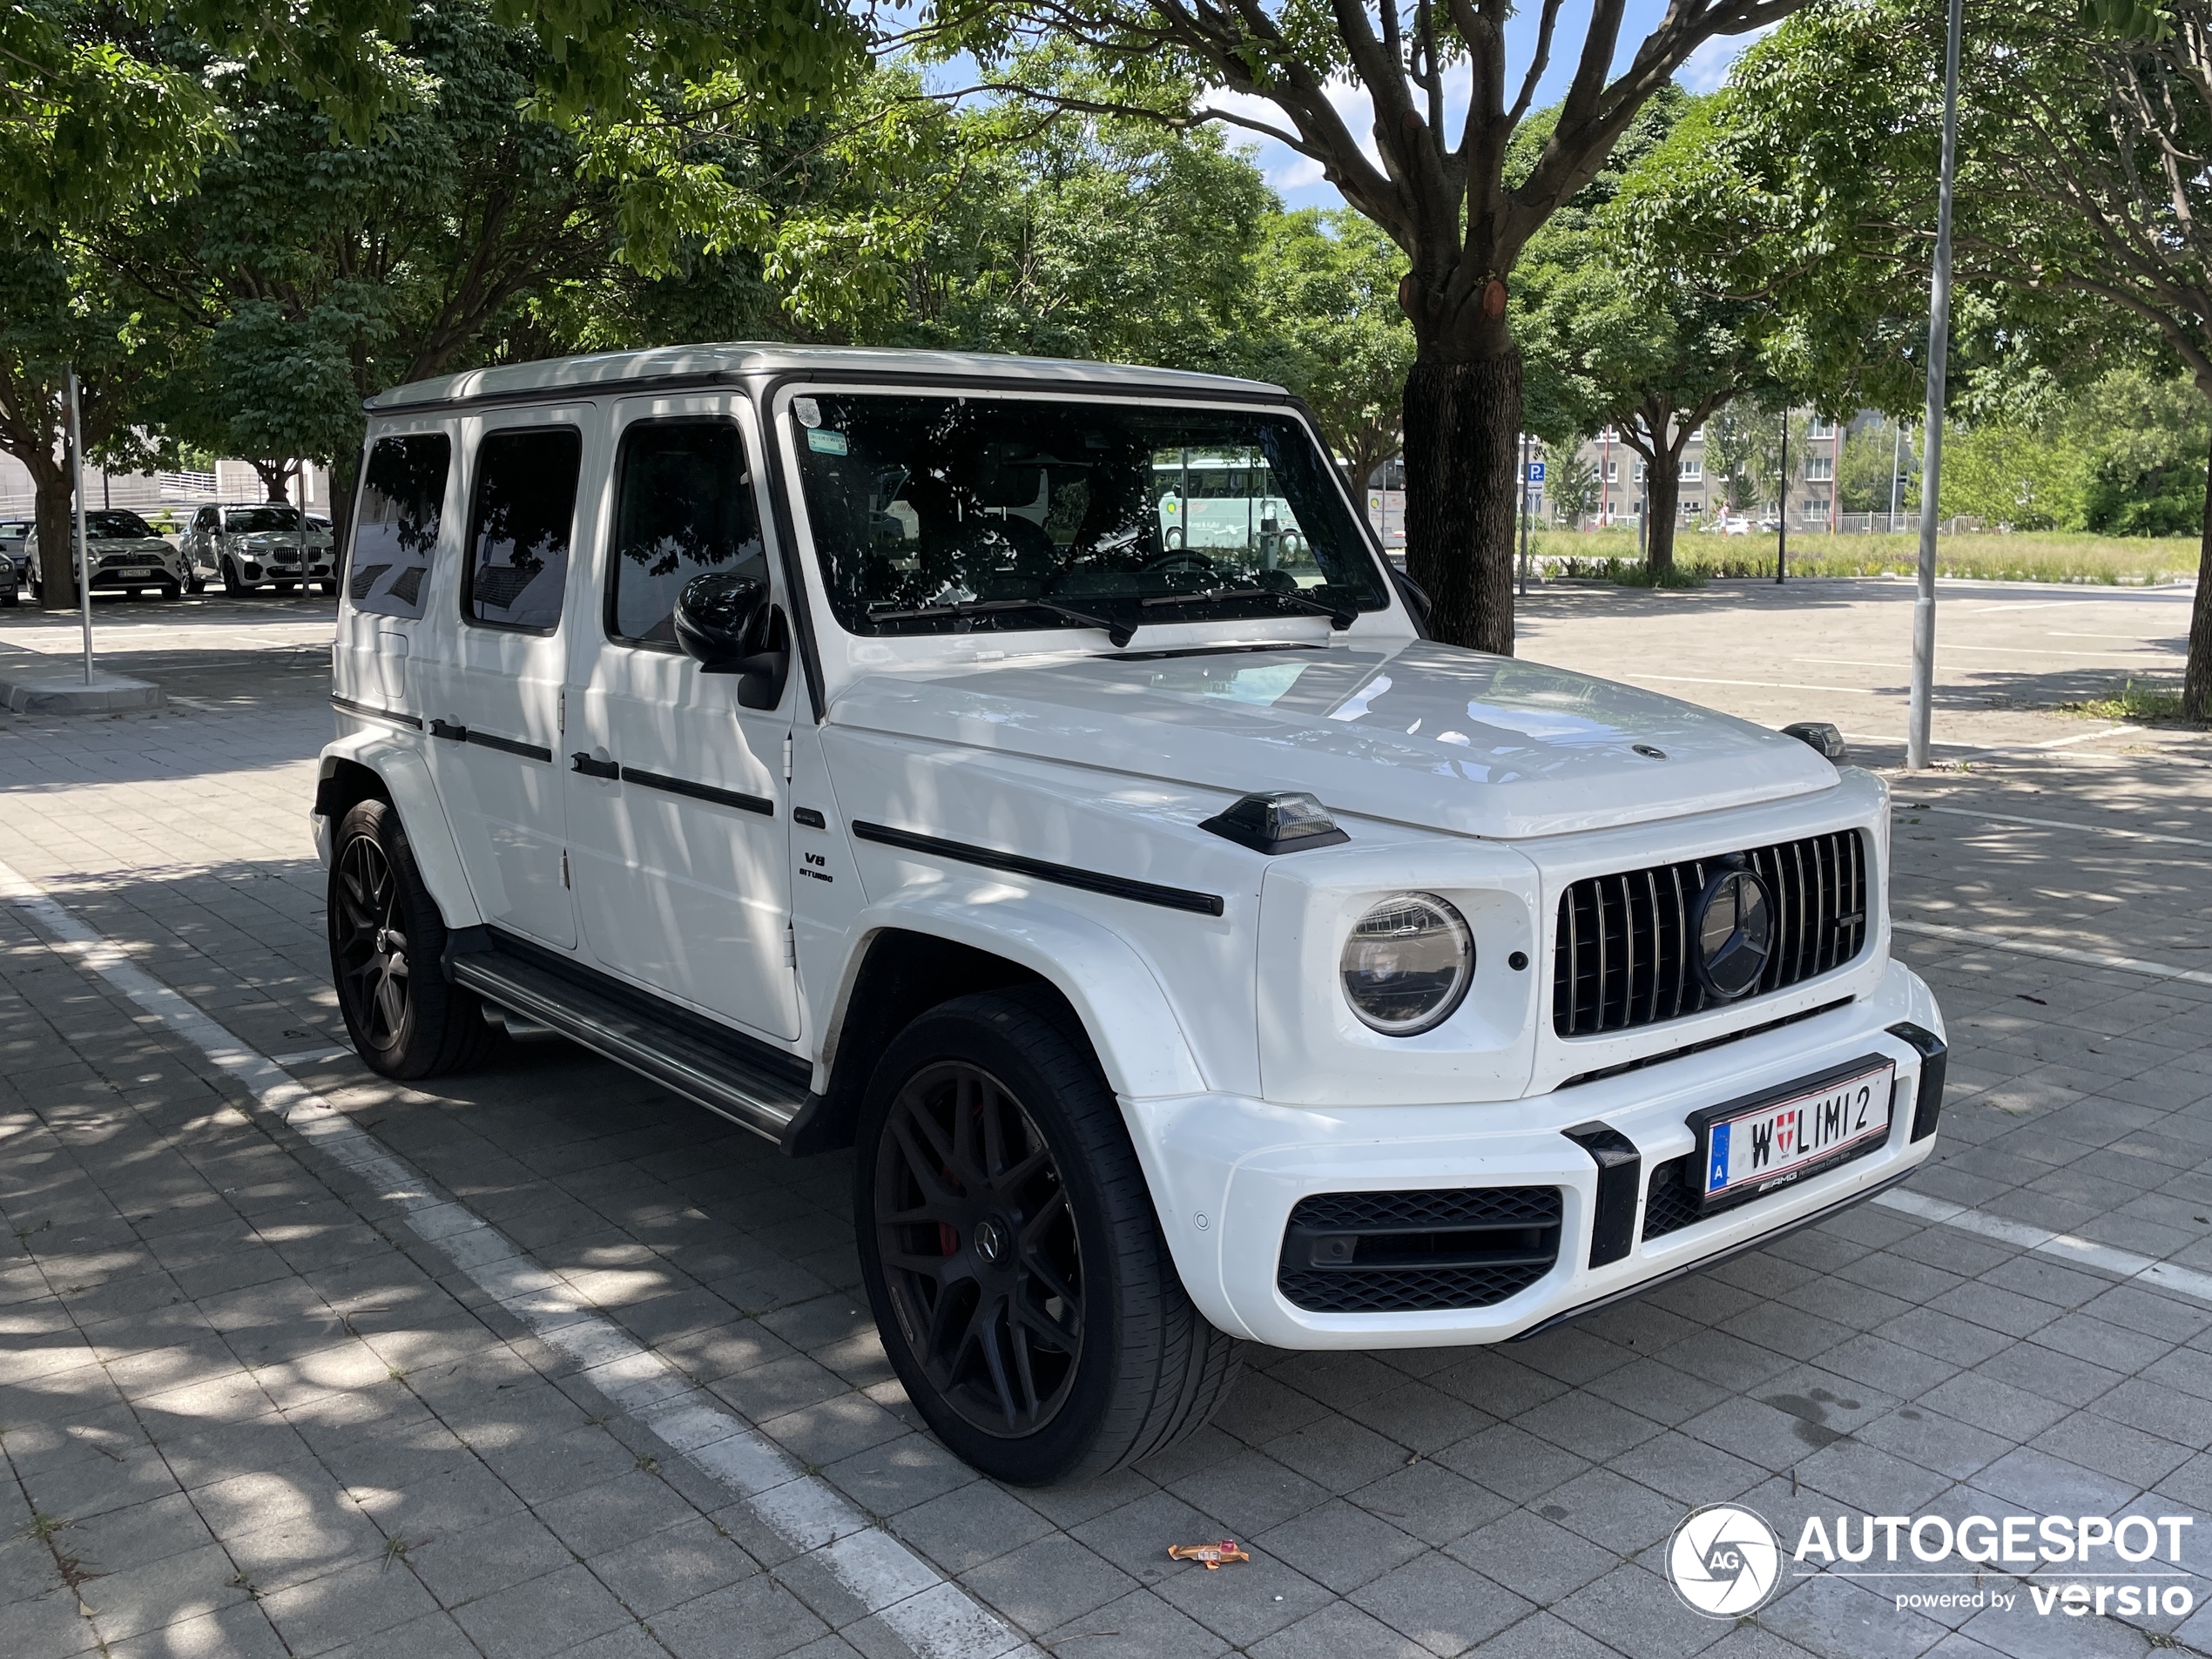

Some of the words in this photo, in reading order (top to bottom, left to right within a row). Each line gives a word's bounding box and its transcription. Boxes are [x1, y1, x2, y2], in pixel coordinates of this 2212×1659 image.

[1530, 464, 1541, 480] P
[805, 852, 826, 867] V8
[799, 867, 833, 883] BITURBO
[1752, 1118, 1774, 1169] W
[1855, 1085, 1870, 1130] 2
[1714, 1165, 1723, 1180] A
